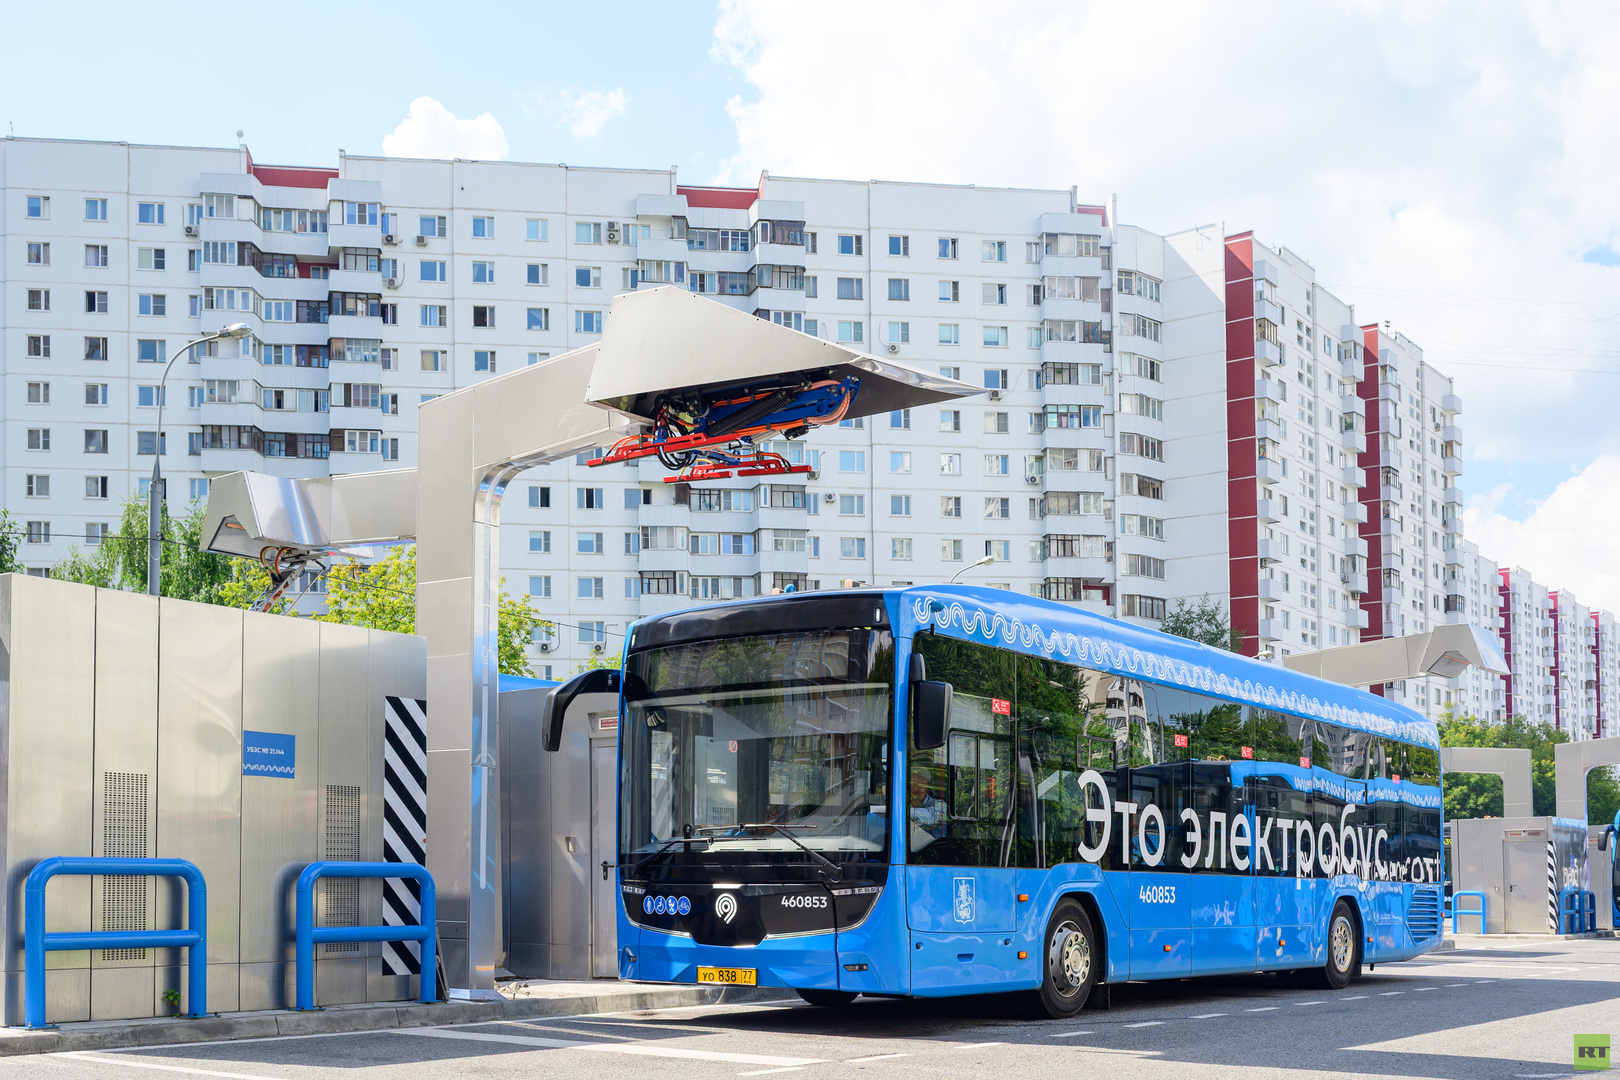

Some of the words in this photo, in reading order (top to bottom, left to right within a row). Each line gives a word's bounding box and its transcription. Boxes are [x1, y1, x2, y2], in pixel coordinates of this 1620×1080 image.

[1077, 769, 1165, 867] Это
[1180, 804, 1388, 892] электробус
[781, 895, 828, 908] 460853
[1139, 885, 1176, 904] 460853
[718, 970, 737, 982] 838
[742, 970, 752, 980] 77
